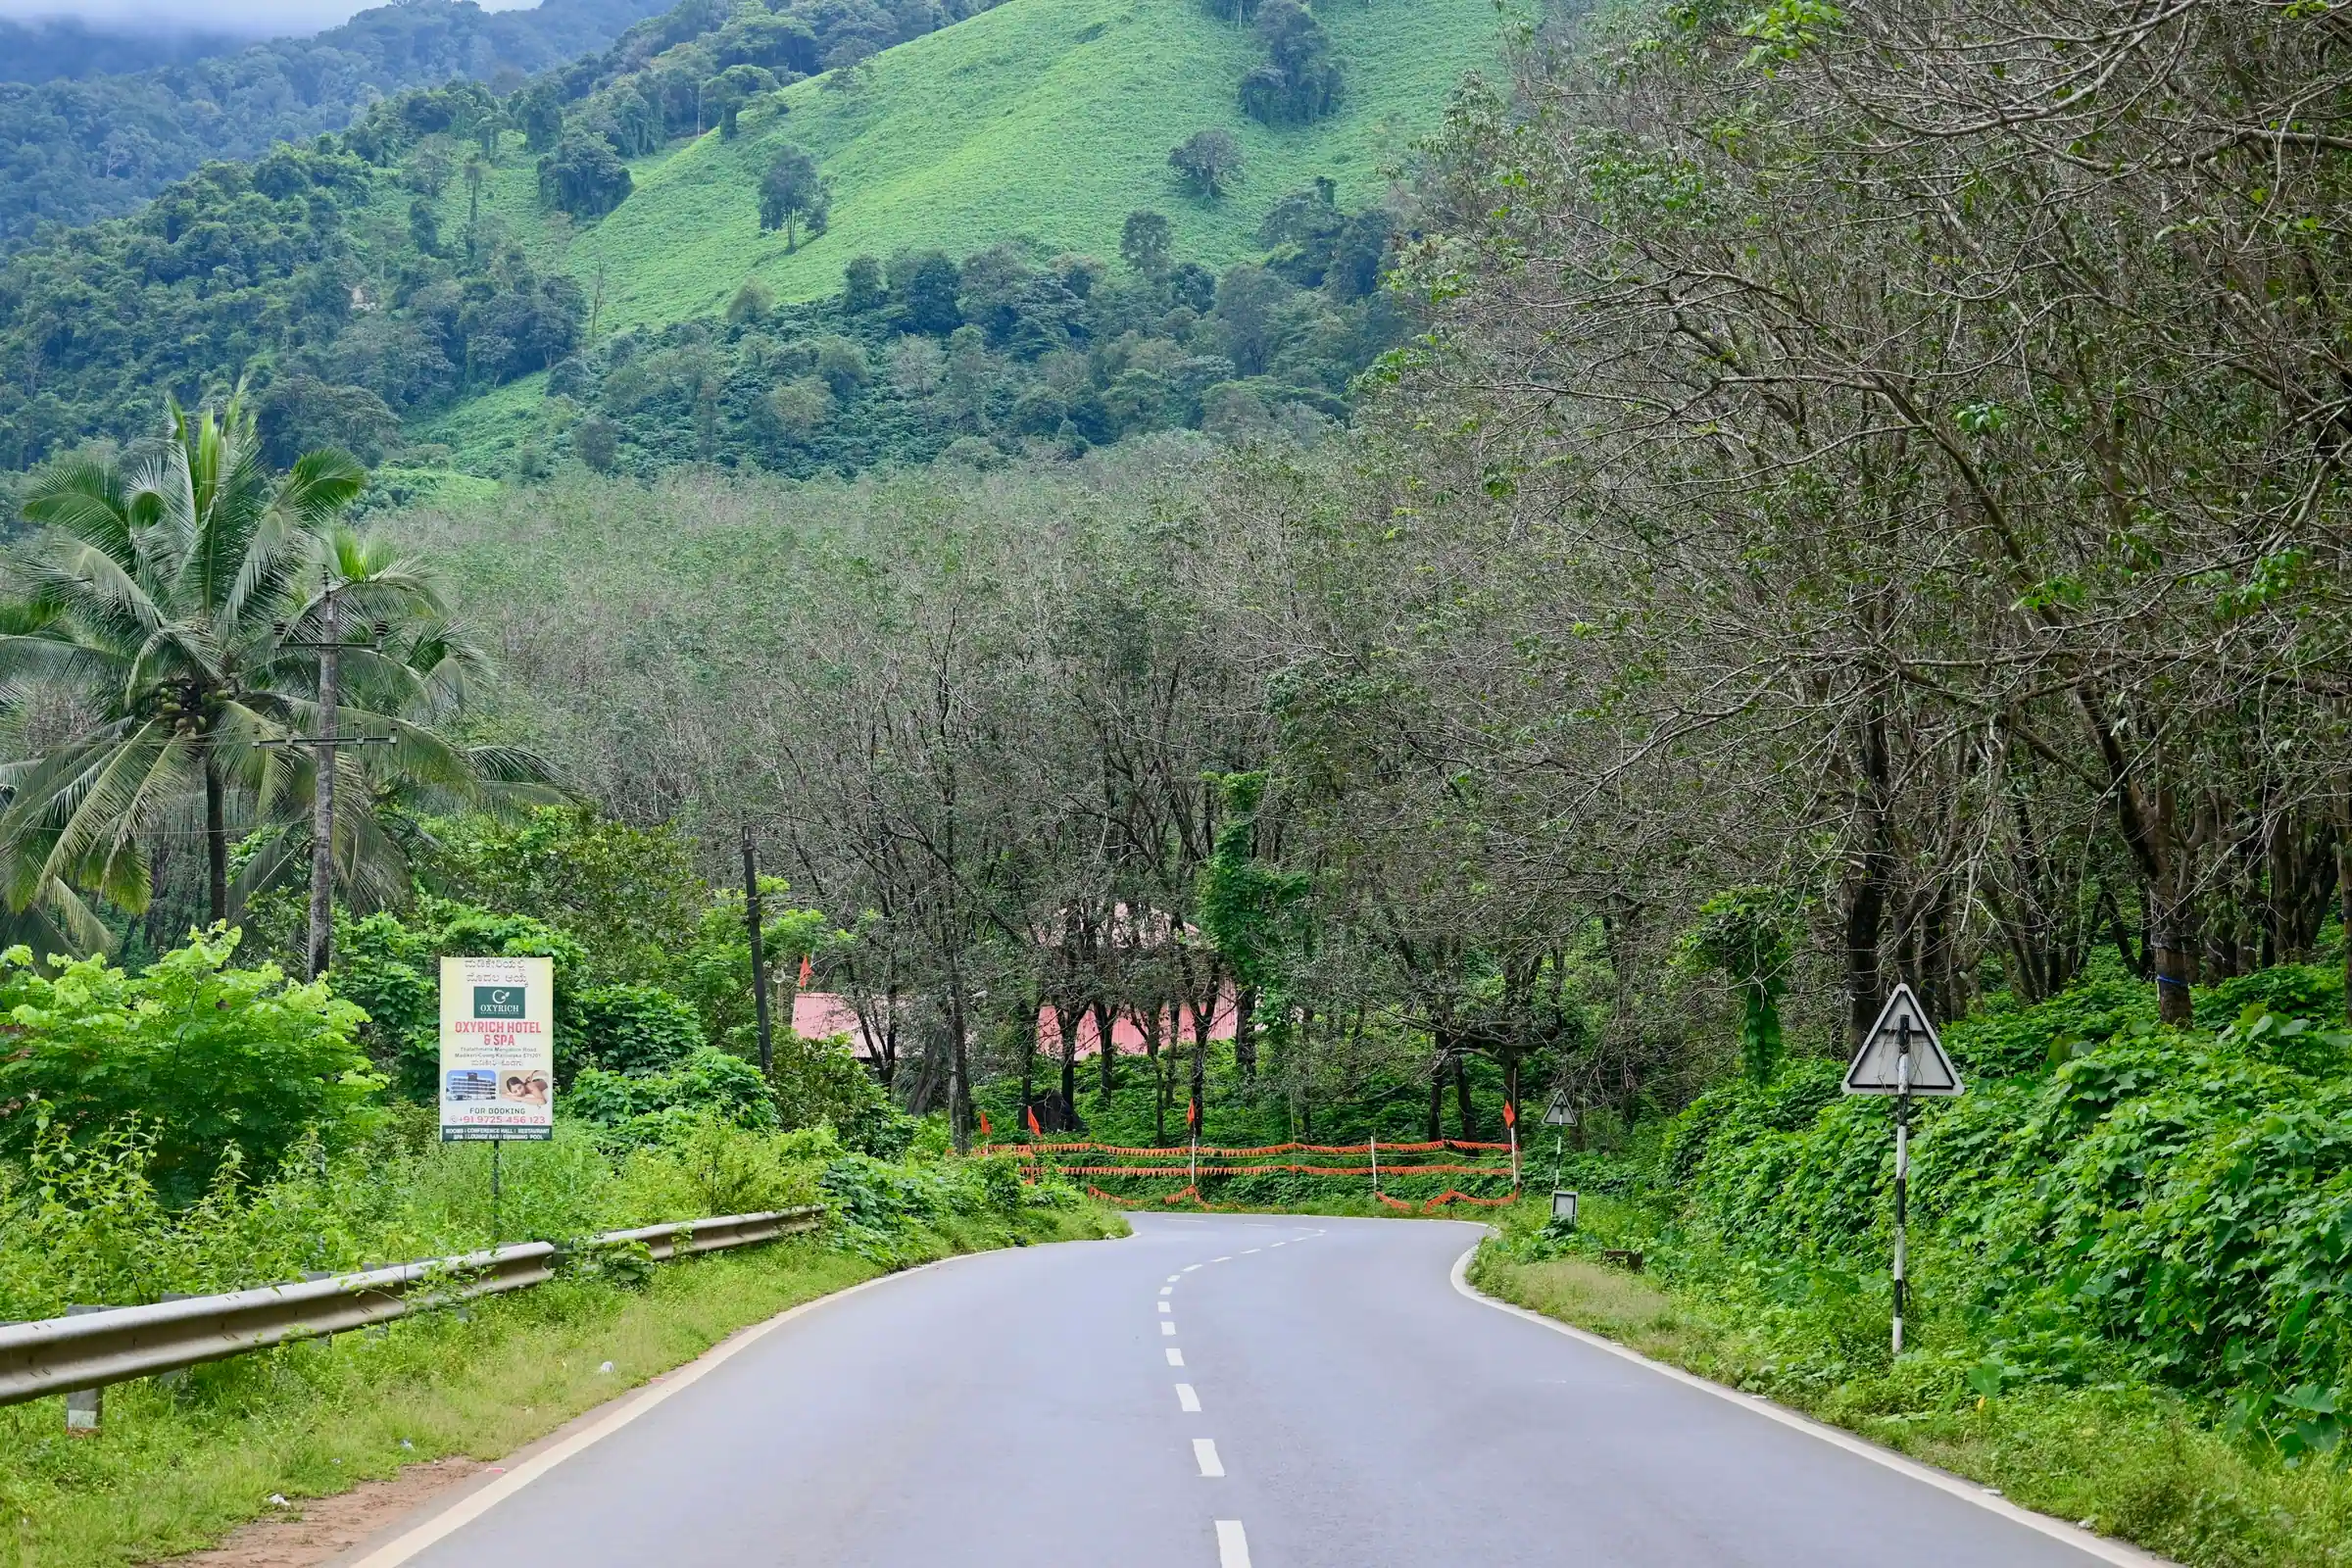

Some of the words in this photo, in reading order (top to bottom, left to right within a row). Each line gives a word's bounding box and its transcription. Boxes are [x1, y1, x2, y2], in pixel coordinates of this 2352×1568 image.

[455, 1021, 505, 1033] OXYRICH
[507, 1021, 541, 1033] HOTEL
[483, 1034, 491, 1046] &
[493, 1034, 515, 1046] SPA
[459, 1115, 474, 1124] +91
[476, 1115, 503, 1124] 9725
[506, 1115, 526, 1124] 456
[529, 1115, 546, 1124] 123
